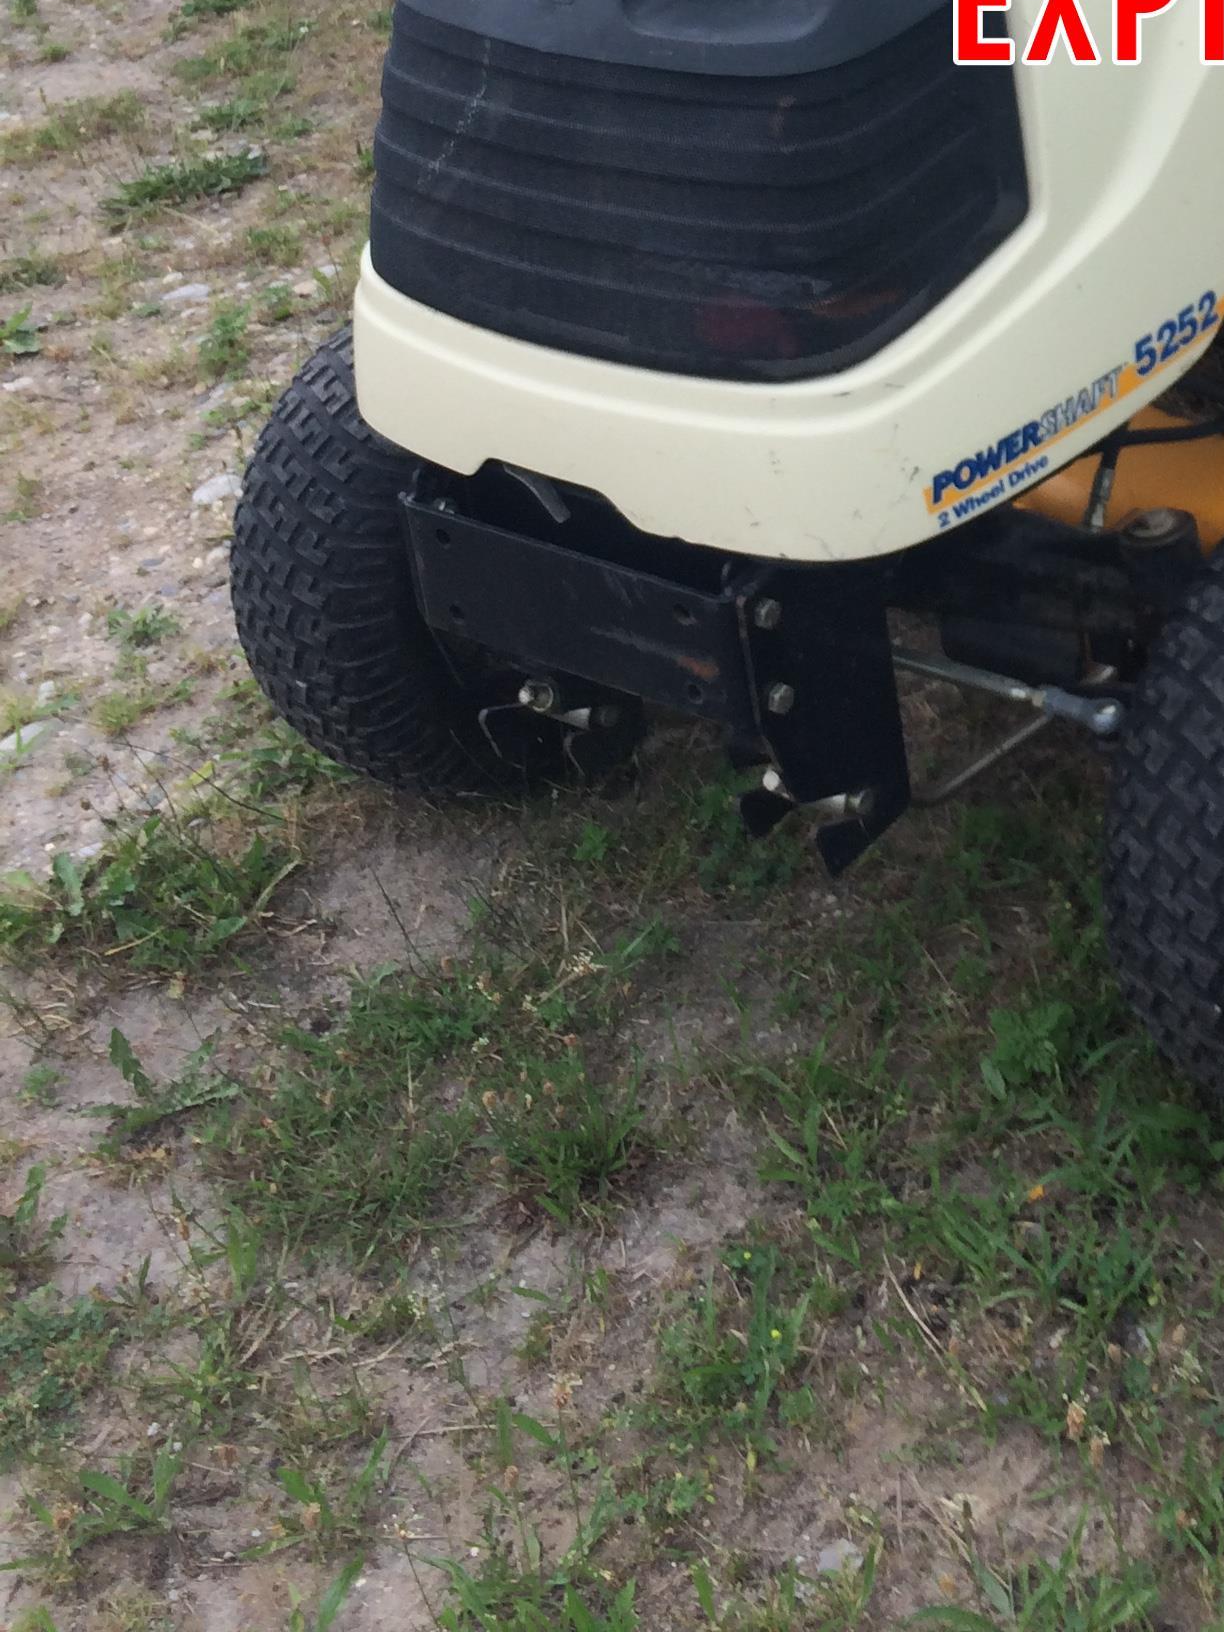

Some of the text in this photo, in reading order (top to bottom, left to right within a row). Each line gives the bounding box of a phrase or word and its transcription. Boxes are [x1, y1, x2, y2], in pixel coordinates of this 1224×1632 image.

[1133, 290, 1219, 377] 5252
[937, 454, 1049, 529] 2 Wheel Drive
